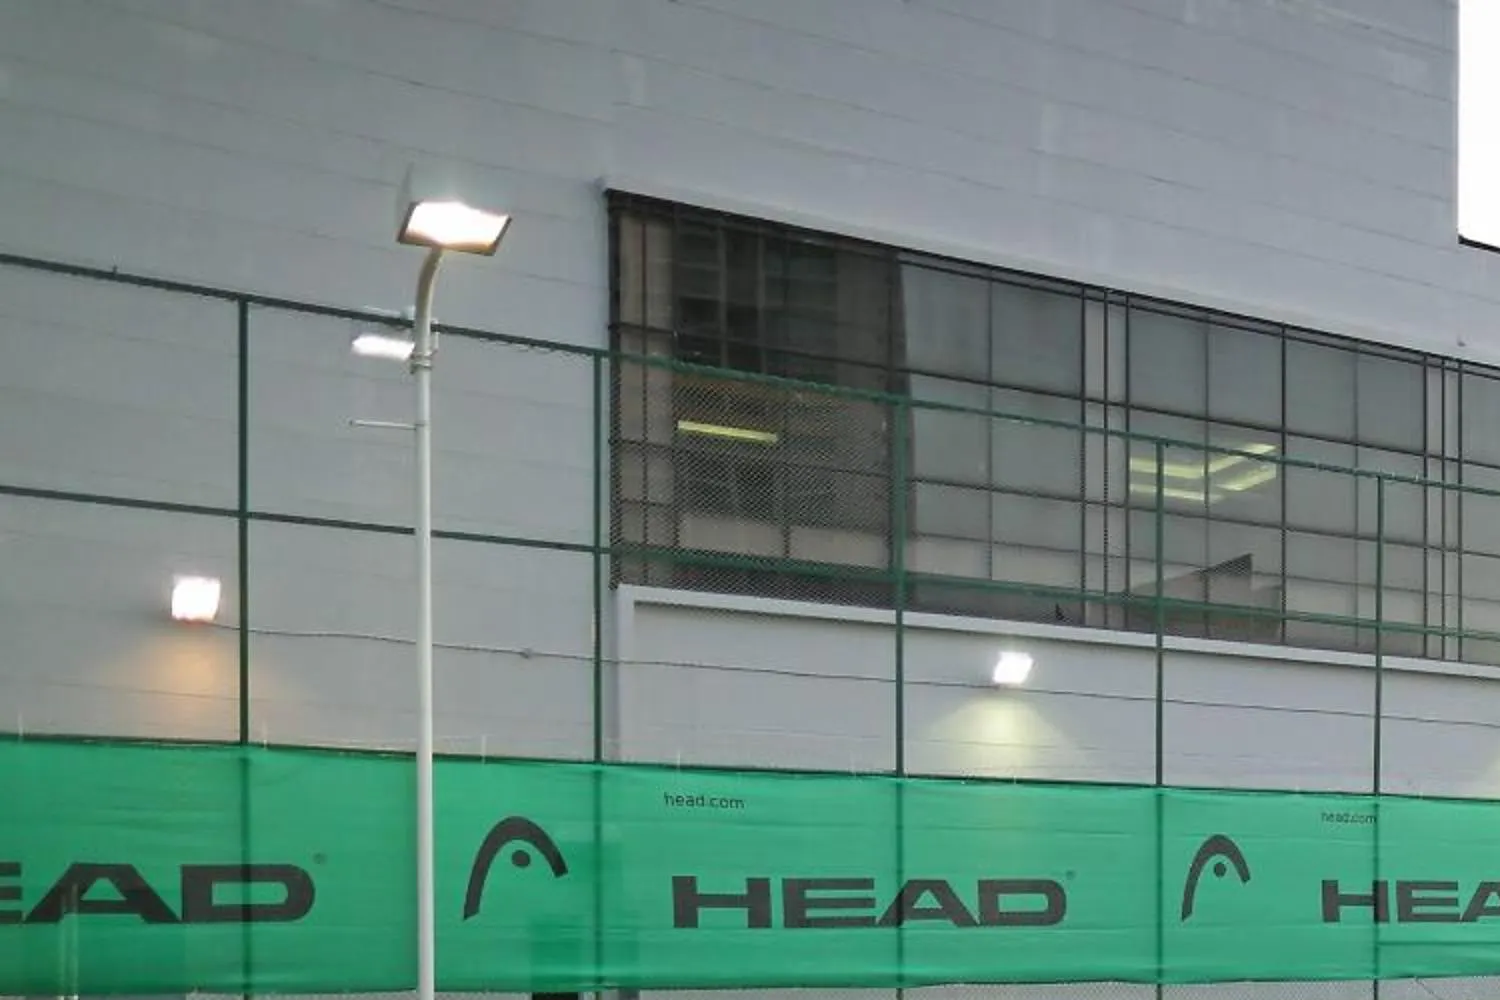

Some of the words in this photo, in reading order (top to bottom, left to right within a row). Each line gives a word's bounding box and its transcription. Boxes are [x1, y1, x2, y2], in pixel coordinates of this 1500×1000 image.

[664, 792, 744, 809] head.com
[0, 862, 315, 923] AD
[672, 876, 1067, 928] HEAD
